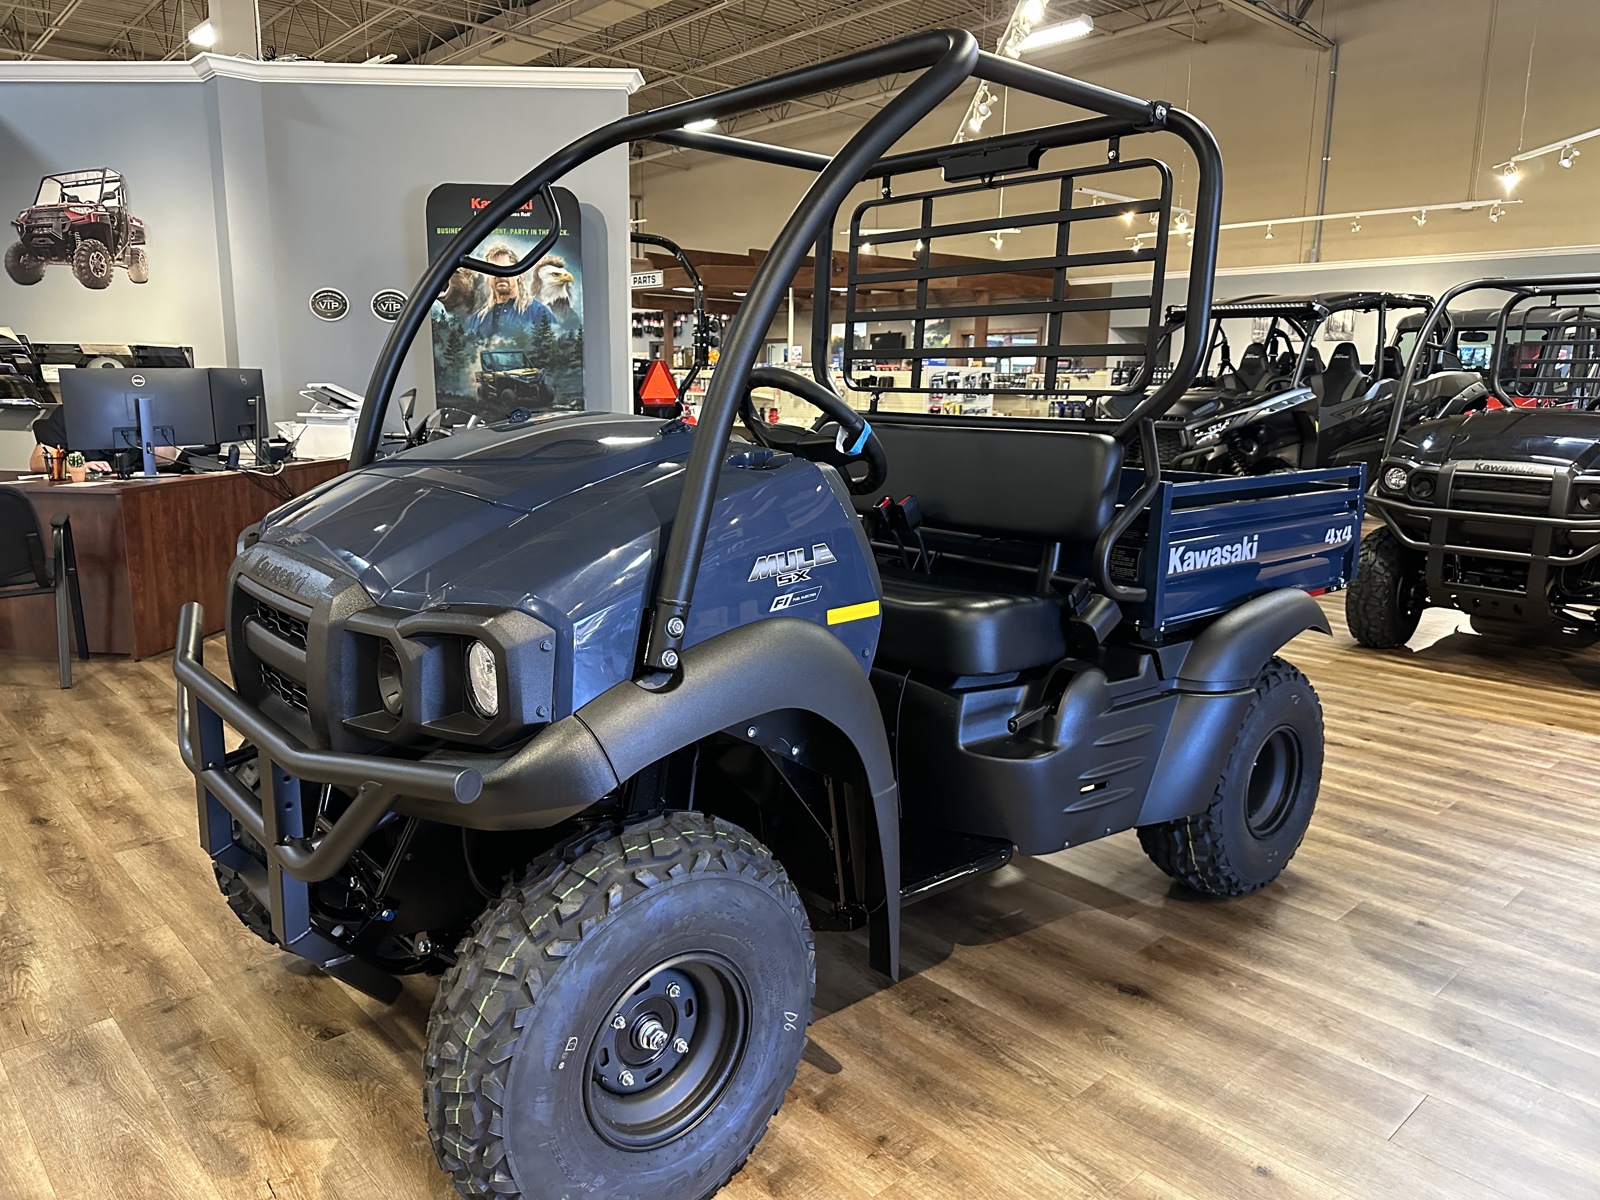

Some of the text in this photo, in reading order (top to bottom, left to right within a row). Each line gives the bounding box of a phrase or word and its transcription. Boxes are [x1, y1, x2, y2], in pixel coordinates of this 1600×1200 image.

[471, 198, 533, 210] Kaki
[436, 227, 462, 236] BUSINE
[509, 228, 529, 236] PARTY
[530, 228, 538, 236] IN
[633, 275, 656, 285] PARTS
[318, 301, 339, 310] VIP
[380, 303, 401, 312] VIP
[1167, 534, 1260, 575] Kawasaki
[1324, 525, 1353, 545] 4x4
[748, 543, 837, 582] MULE
[776, 568, 812, 587] SX
